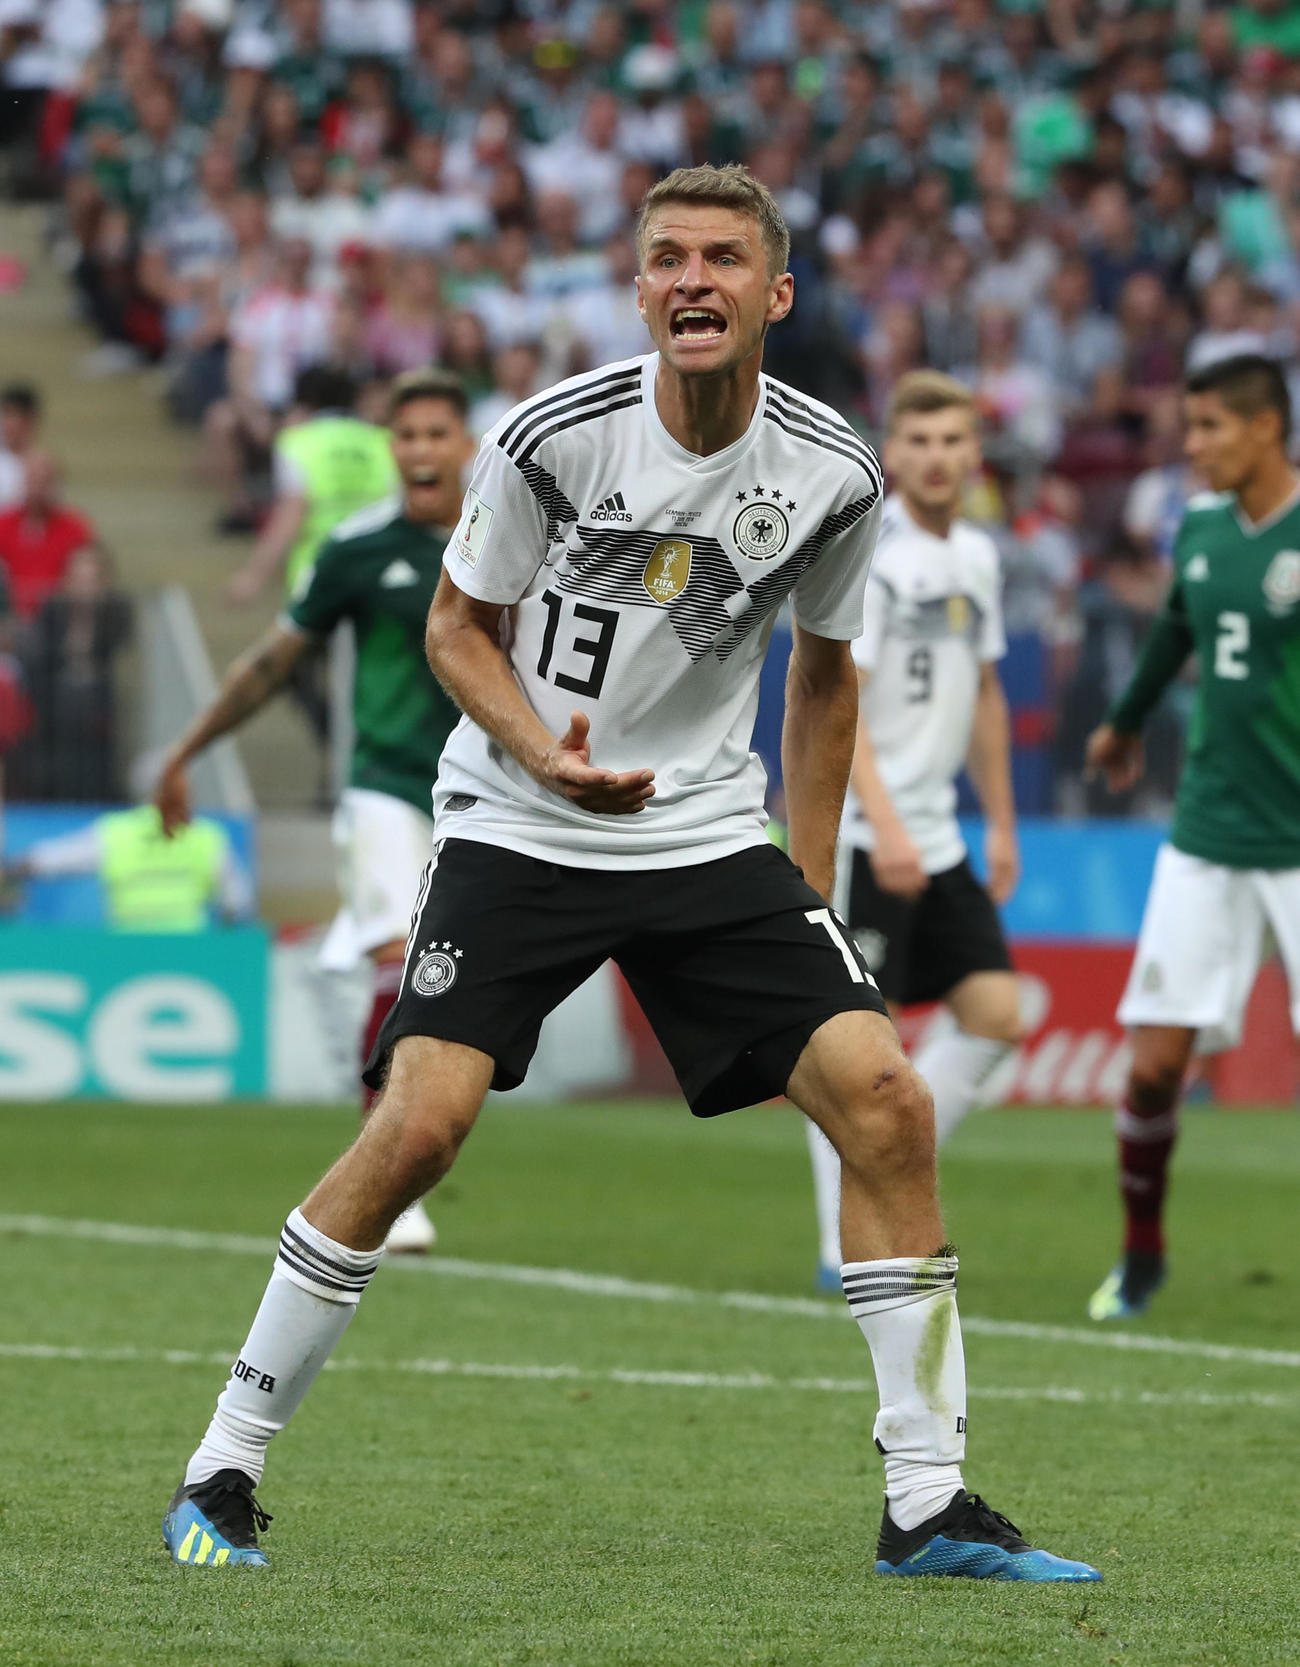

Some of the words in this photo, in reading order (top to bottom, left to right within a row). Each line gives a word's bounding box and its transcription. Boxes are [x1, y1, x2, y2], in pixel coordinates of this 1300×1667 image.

[590, 509, 633, 523] adidas
[653, 578, 674, 589] FIFA
[537, 588, 620, 700] 13
[1214, 611, 1250, 680] 2
[907, 645, 935, 703] 9
[234, 1359, 277, 1394] DFB
